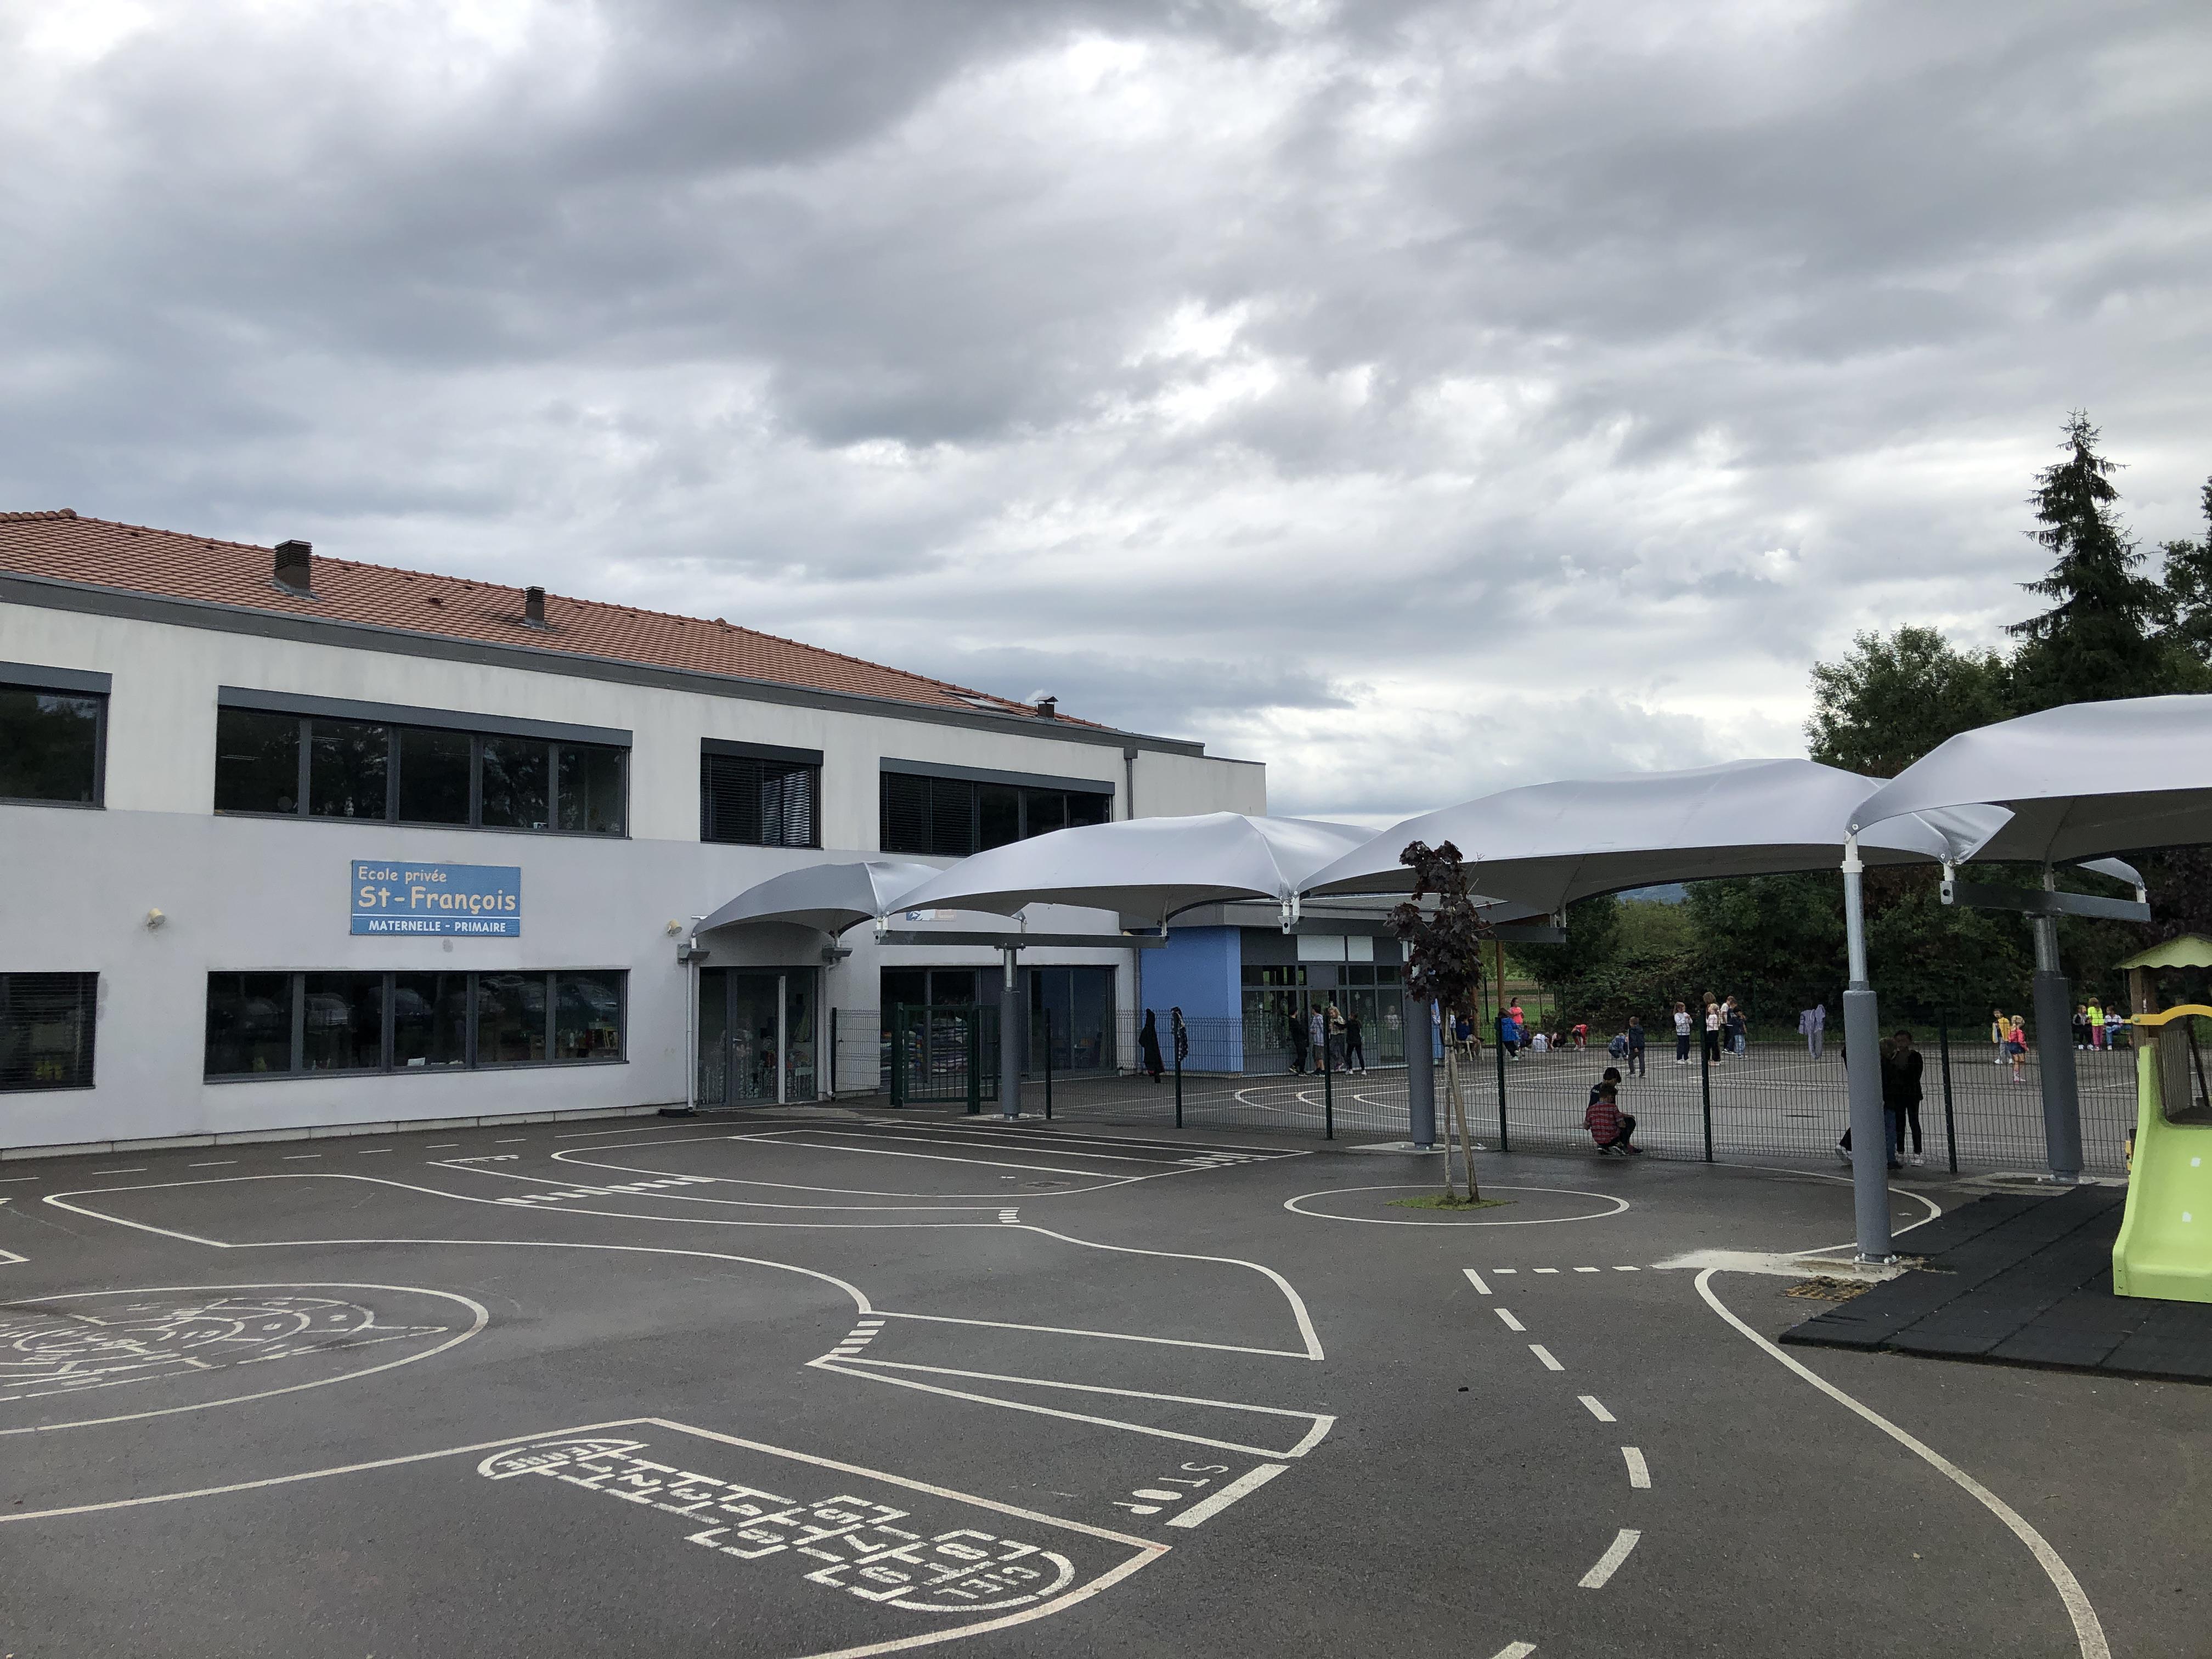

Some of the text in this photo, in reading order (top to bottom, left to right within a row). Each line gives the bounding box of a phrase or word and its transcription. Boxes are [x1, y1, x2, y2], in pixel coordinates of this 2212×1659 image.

[358, 866, 447, 884] Ecole privée
[368, 920, 441, 932] MATERNELLE
[454, 921, 506, 933] PRIMAIRE
[669, 1487, 713, 1500] 3
[1112, 1462, 1229, 1515] STOP
[933, 1566, 1041, 1599] CIEL
